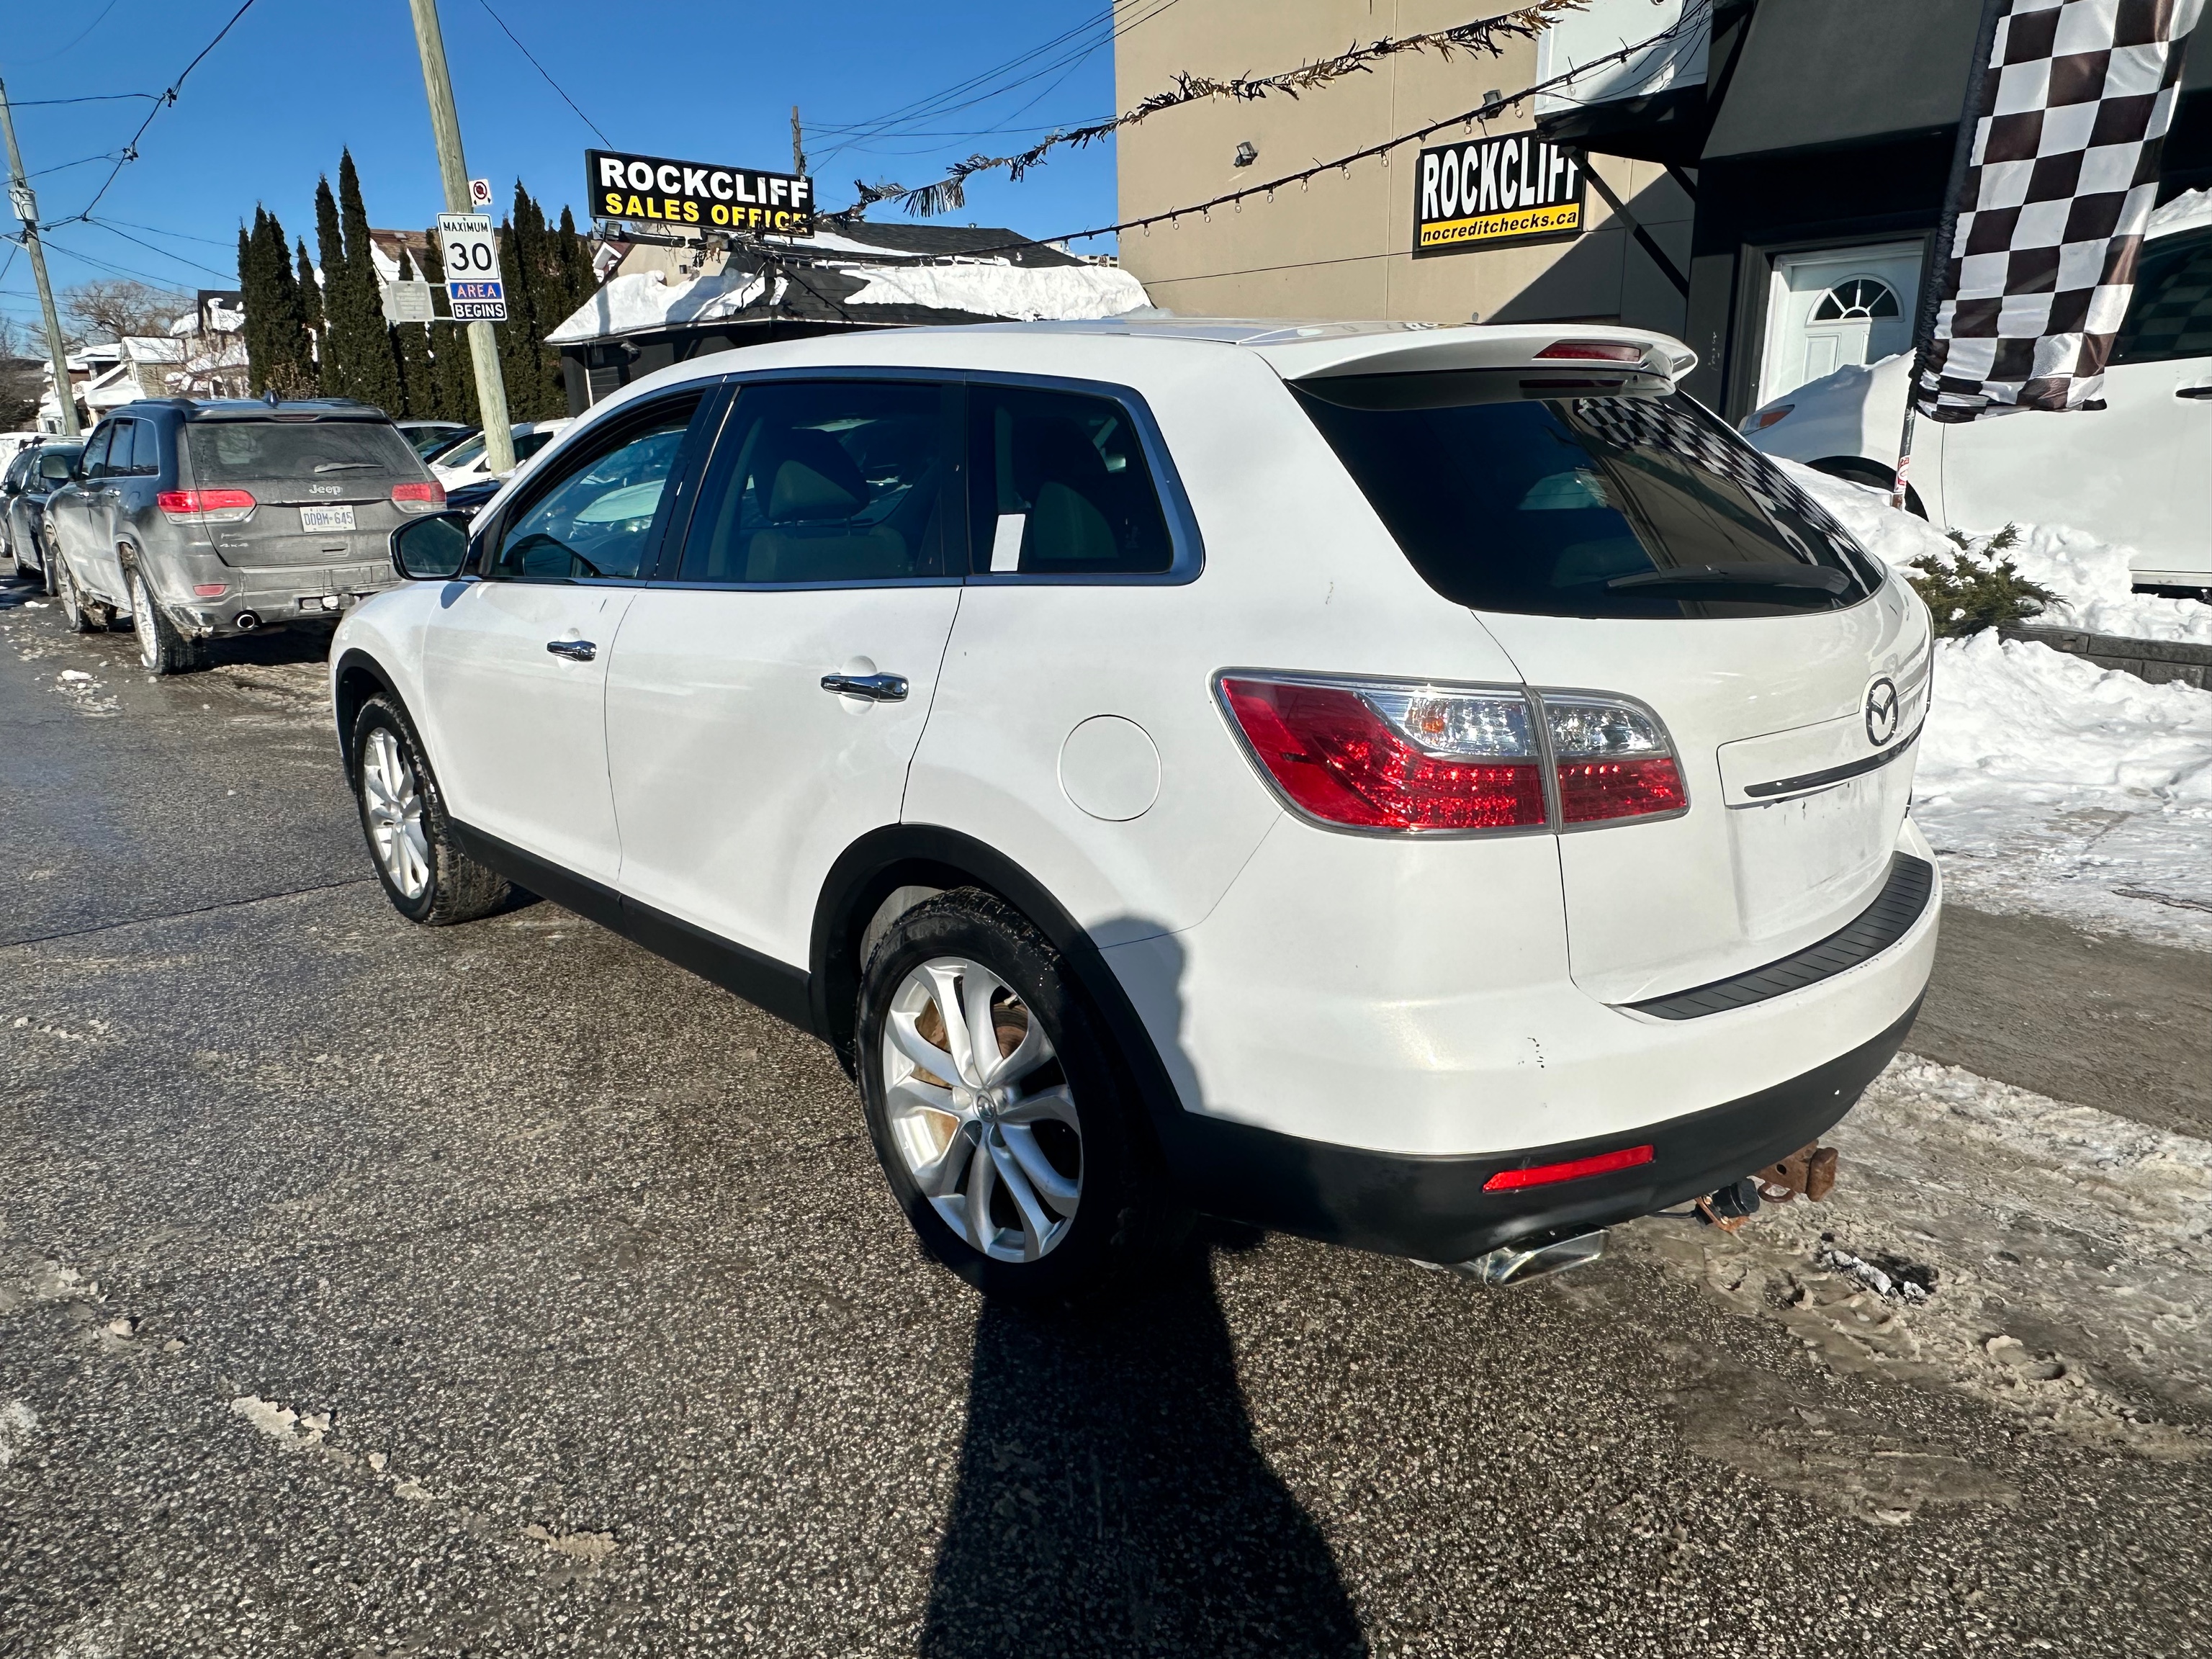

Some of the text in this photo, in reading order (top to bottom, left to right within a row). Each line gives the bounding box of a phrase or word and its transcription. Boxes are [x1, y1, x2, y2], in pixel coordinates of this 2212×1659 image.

[599, 157, 809, 208] ROCKCLIFF
[606, 193, 699, 222] SALES
[443, 222, 489, 233] MAXIMUM
[1422, 211, 1577, 243] nocreditchecks.ca
[449, 242, 492, 271] 30
[457, 284, 497, 298] AREA
[454, 304, 504, 318] BEGINS
[309, 485, 342, 495] Jeep
